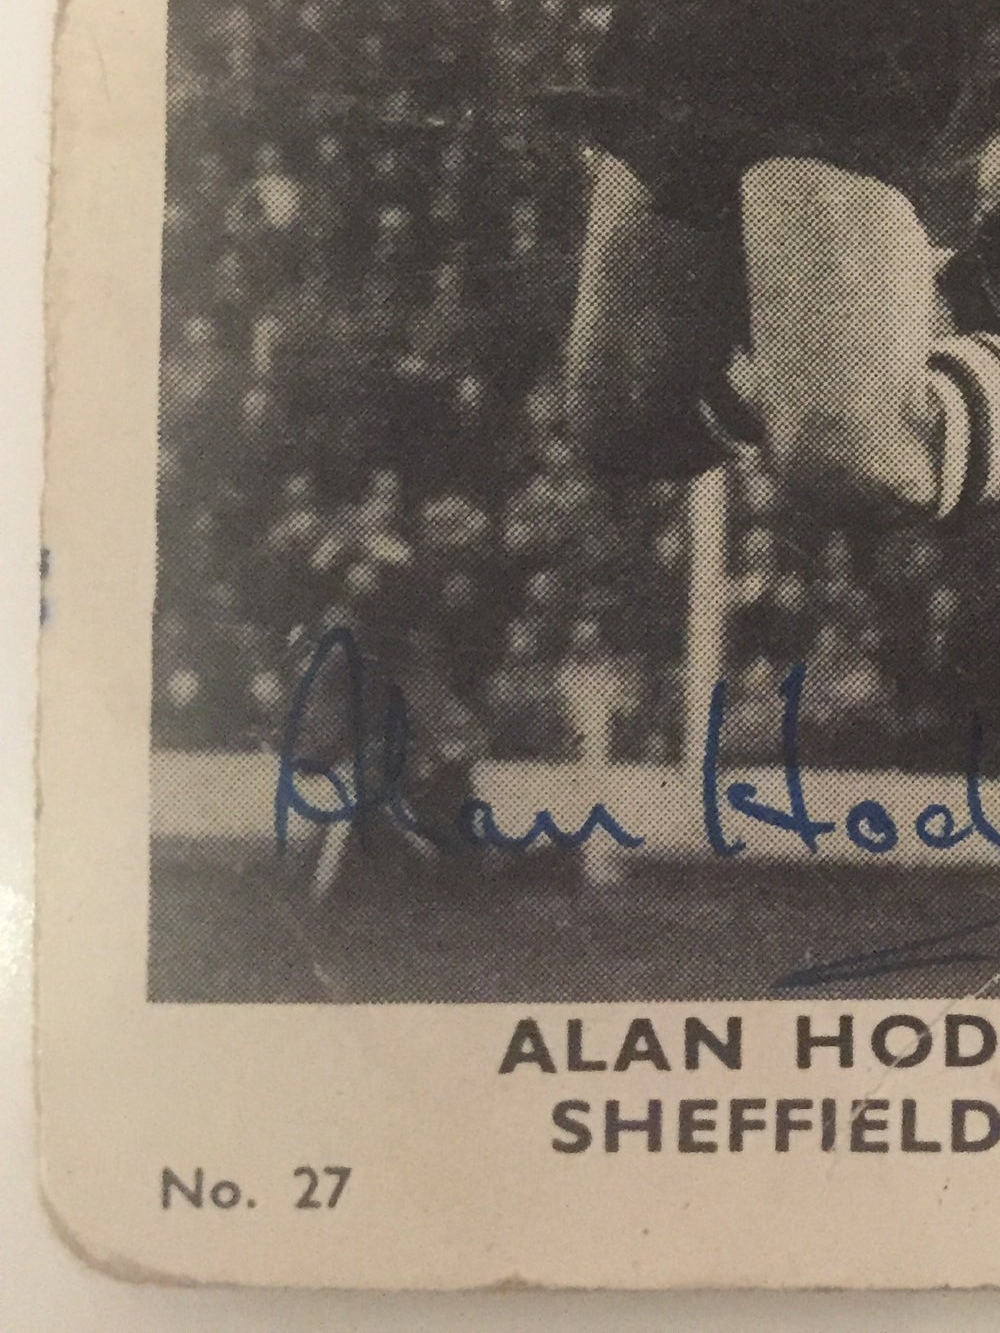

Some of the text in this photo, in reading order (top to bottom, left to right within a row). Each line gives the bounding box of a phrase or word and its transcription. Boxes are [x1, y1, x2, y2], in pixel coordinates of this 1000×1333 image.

[272, 626, 646, 858] Alan
[497, 1015, 743, 1075] ALAN
[160, 1165, 352, 1211] No. 27
